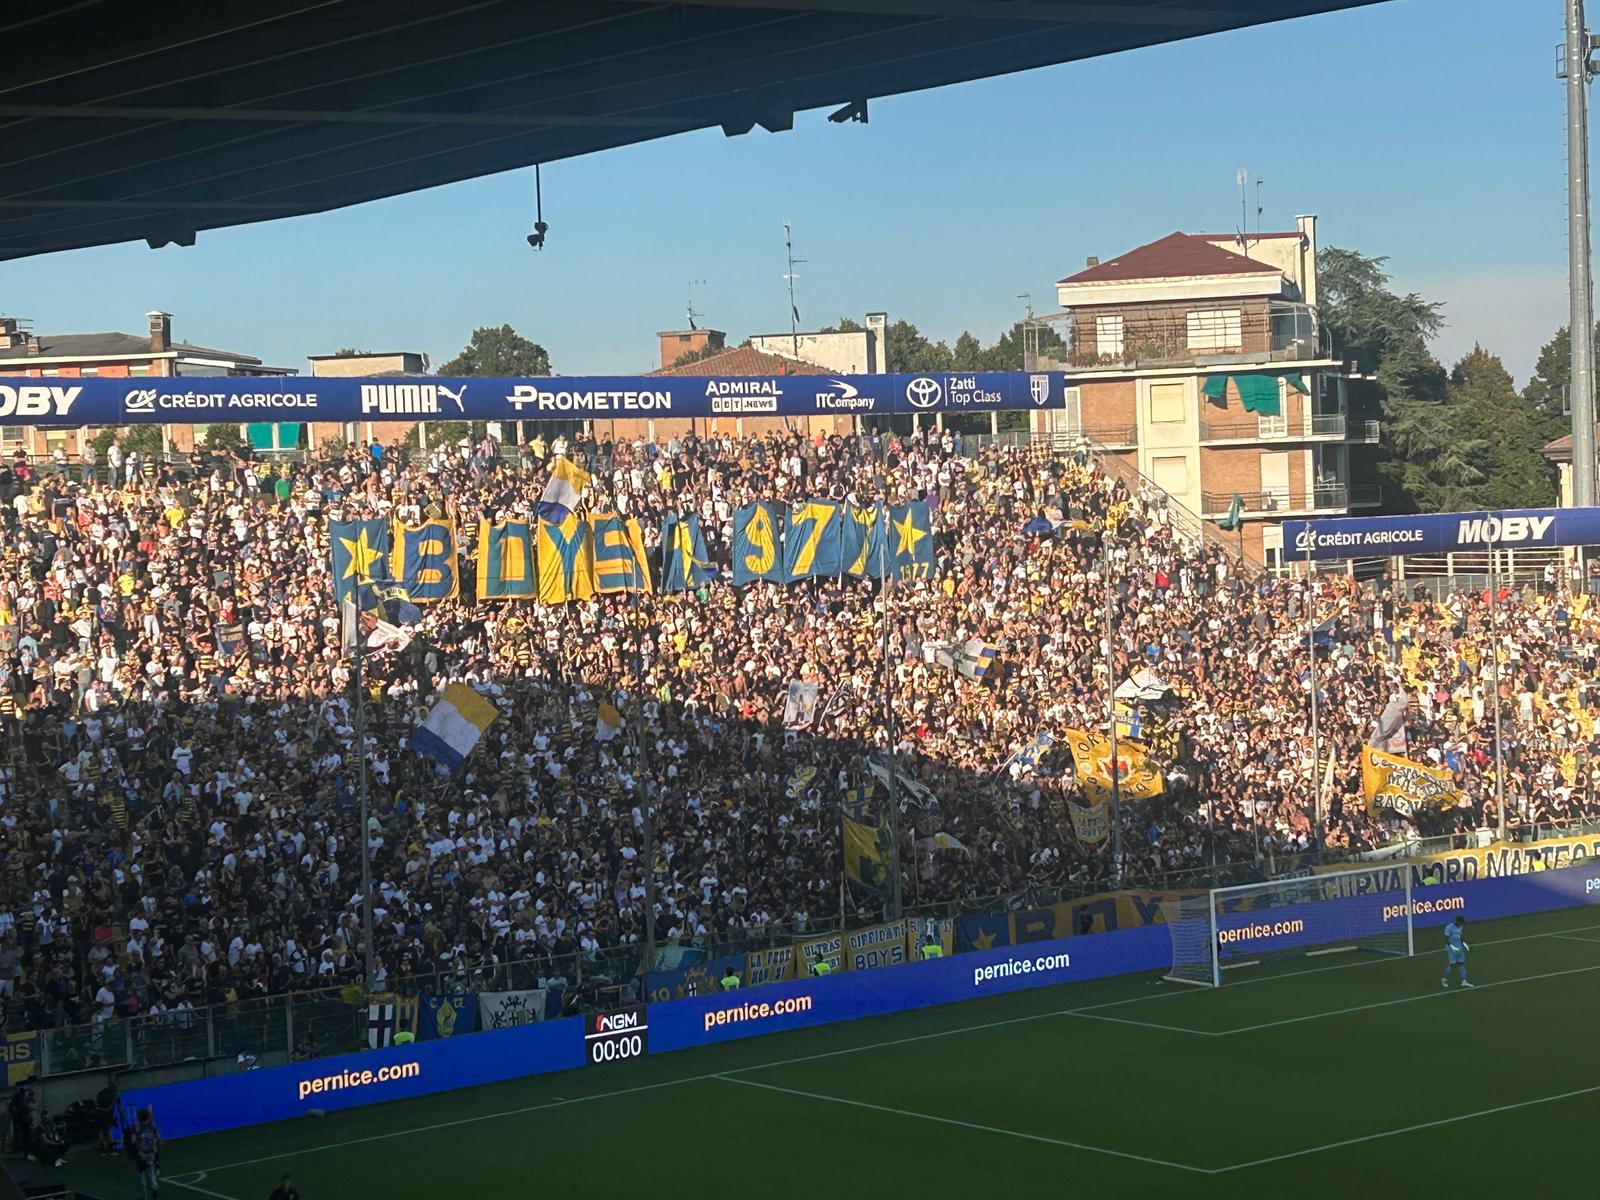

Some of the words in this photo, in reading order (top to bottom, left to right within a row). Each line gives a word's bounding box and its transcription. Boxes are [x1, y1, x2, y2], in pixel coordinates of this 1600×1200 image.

[705, 380, 783, 396] ADMIRAL
[950, 377, 976, 390] Zatti
[159, 391, 225, 408] CRÉDIT
[228, 394, 317, 408] AGRICOLE
[360, 384, 438, 413] PUMA
[506, 385, 672, 411] PROMETEON
[950, 391, 971, 405] Top
[973, 390, 1002, 403] Class
[1318, 531, 1362, 547] CRÉDIT
[1364, 530, 1423, 545] AGRICOLE
[1457, 515, 1555, 544] MOBY
[1411, 857, 1478, 887] NORD
[1219, 918, 1304, 944] pernice.com
[804, 938, 840, 957] ULTRAS
[856, 946, 902, 969] BOYS
[974, 952, 1070, 985] pernice.com
[600, 1012, 637, 1031] NGM
[704, 994, 813, 1031] pernice.com
[592, 1035, 642, 1063] 00:00
[298, 1061, 420, 1100] pernice.com
